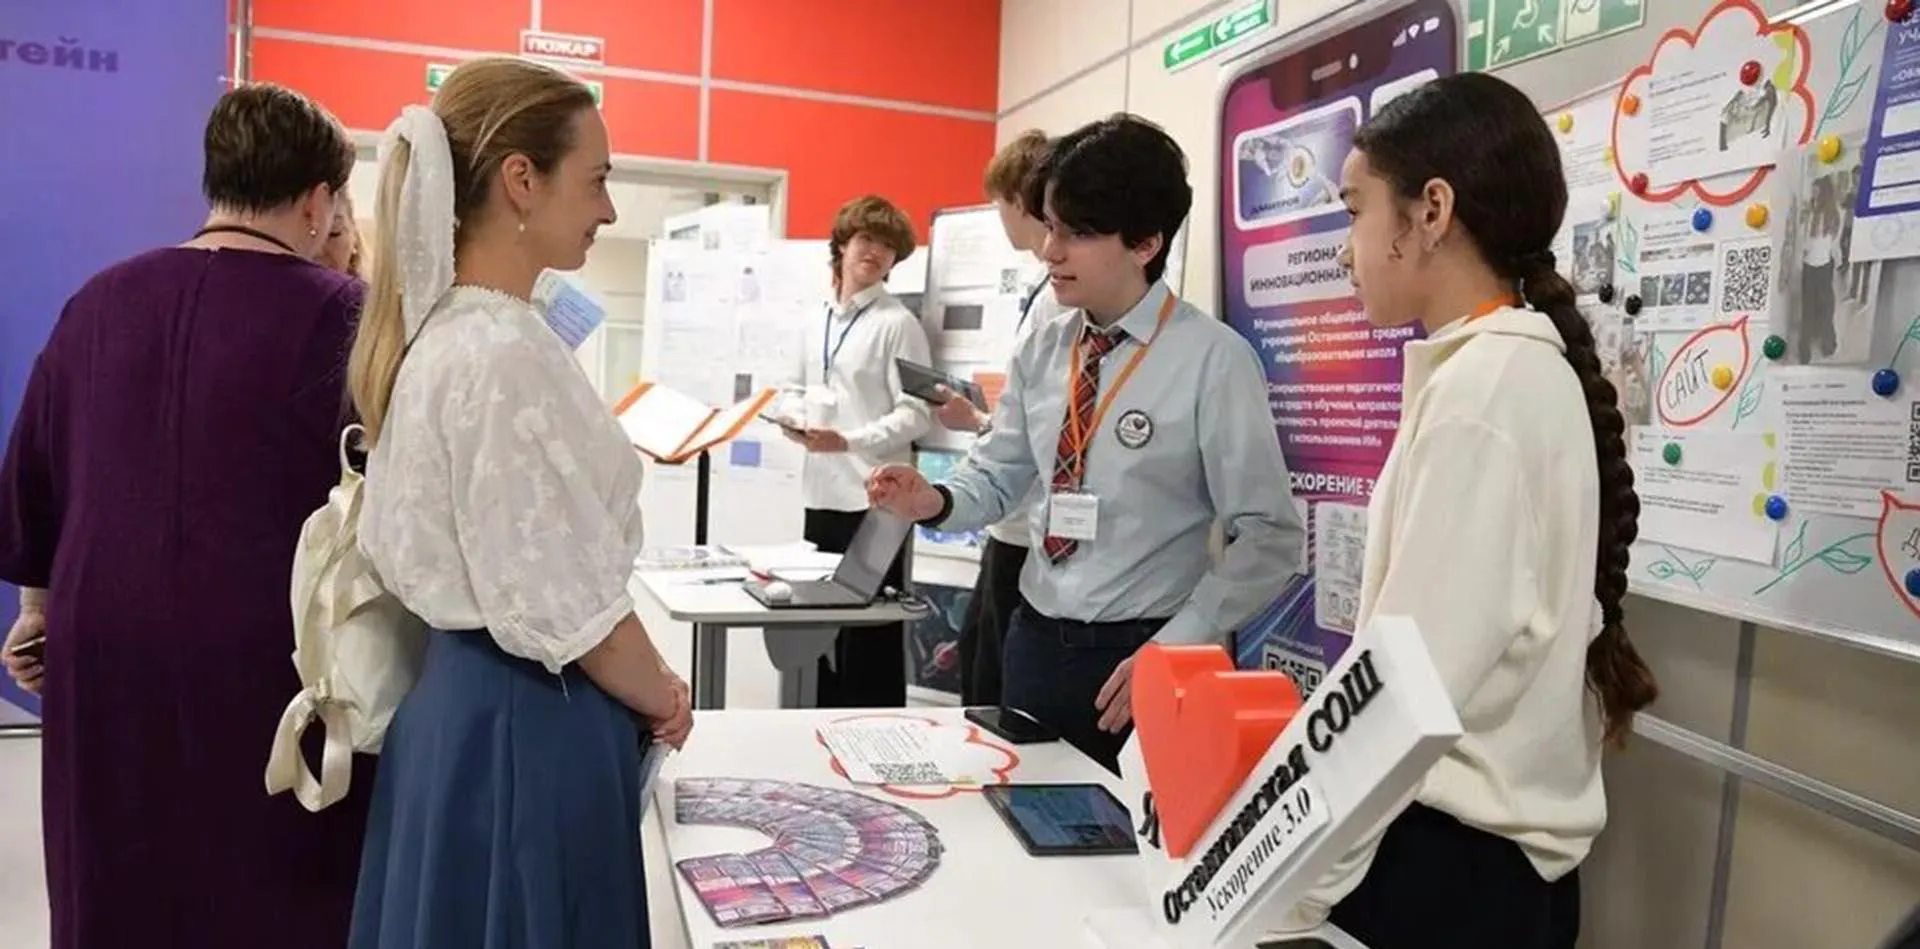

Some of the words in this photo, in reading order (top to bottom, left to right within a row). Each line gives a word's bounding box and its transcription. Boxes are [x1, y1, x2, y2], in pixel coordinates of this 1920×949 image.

[0, 36, 118, 73] тейн
[527, 37, 597, 56] ПОЖАР
[1665, 348, 1709, 409] САЙТ
[1287, 471, 1364, 496] СКОРЕНИЕ
[1307, 649, 1385, 753] СОШ
[1281, 786, 1312, 835] 3.0
